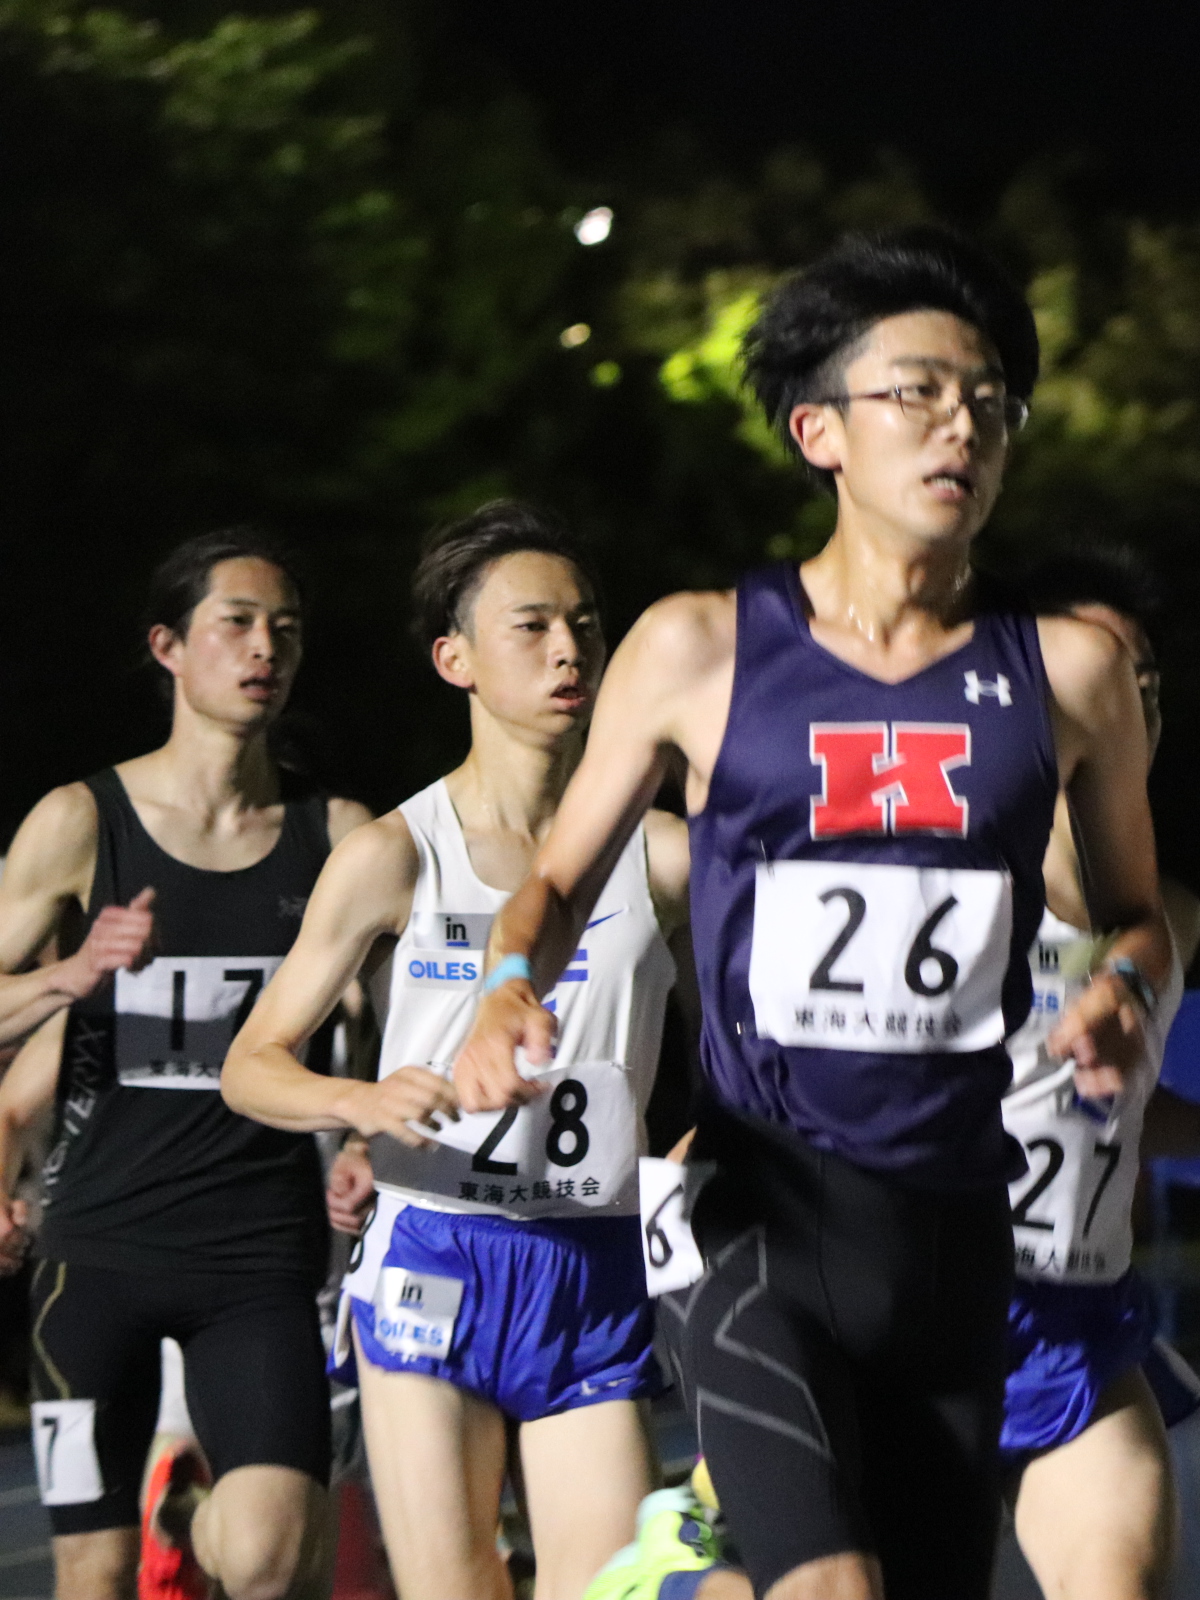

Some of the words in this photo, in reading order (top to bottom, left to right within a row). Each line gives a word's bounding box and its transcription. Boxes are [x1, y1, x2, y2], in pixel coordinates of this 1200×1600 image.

[445, 917, 467, 940] in
[809, 886, 959, 997] 26
[408, 959, 478, 981] OILES
[170, 968, 265, 1051] 17
[471, 1078, 590, 1176] 28
[458, 1176, 600, 1205] 東海大競技会
[645, 1183, 684, 1268] 6
[1011, 1138, 1121, 1239] 27
[401, 1277, 423, 1303] in
[42, 1416, 58, 1490] 7
